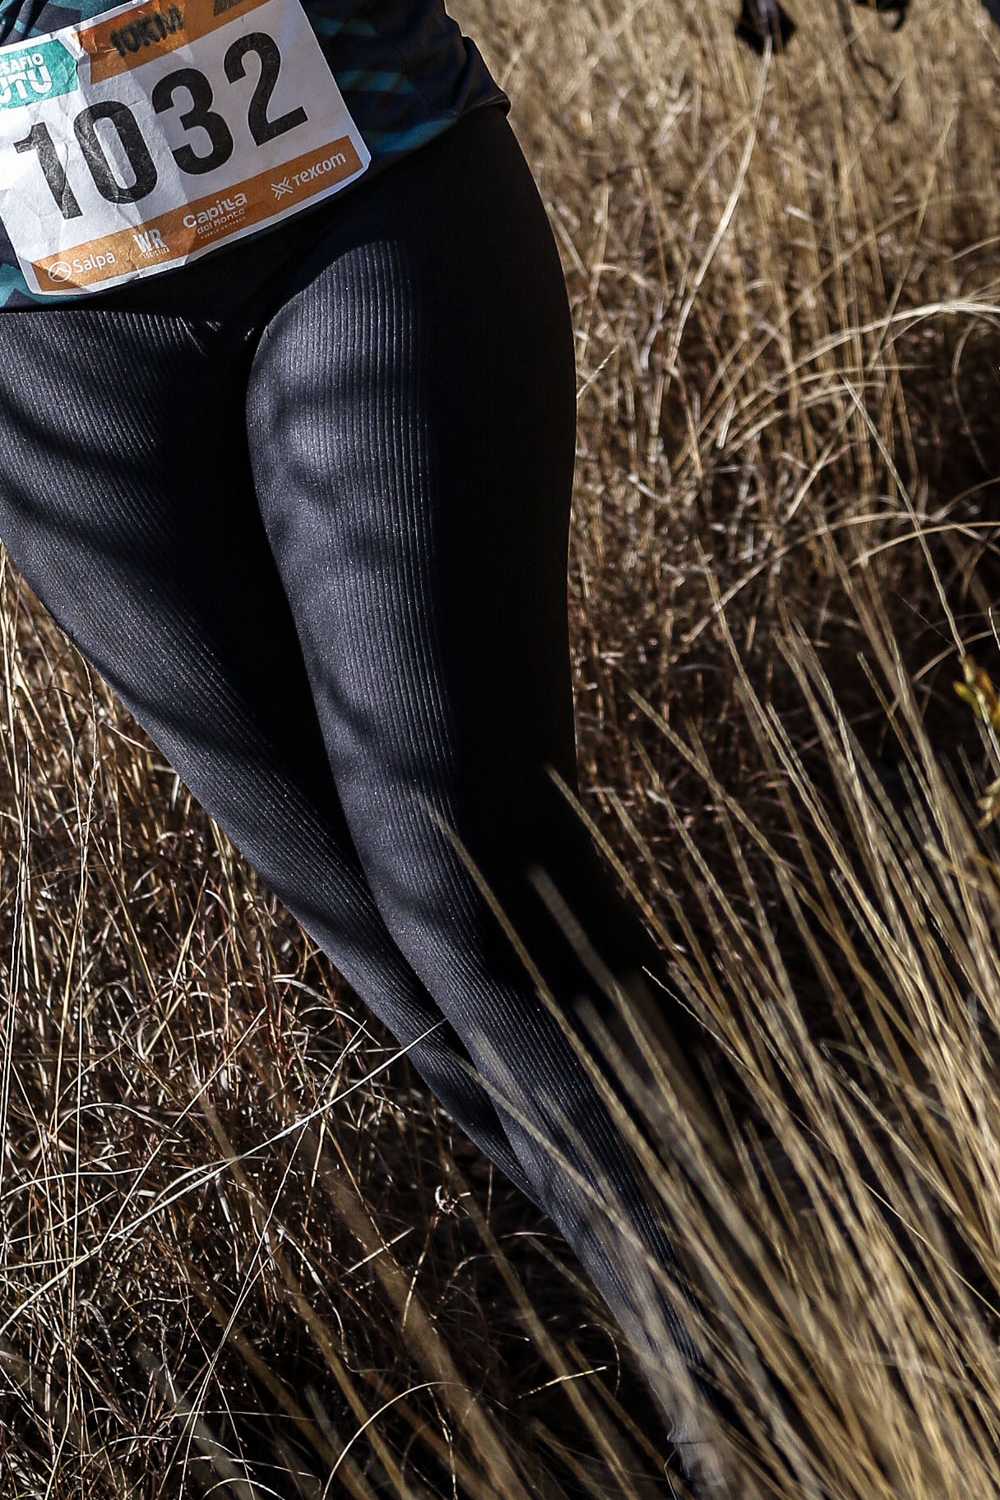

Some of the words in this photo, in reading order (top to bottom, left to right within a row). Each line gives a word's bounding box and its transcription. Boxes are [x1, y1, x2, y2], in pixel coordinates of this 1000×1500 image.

[12, 31, 309, 220] 1032
[213, 207, 246, 228] Monte
[132, 228, 167, 253] WR
[71, 251, 116, 274] Salpa
